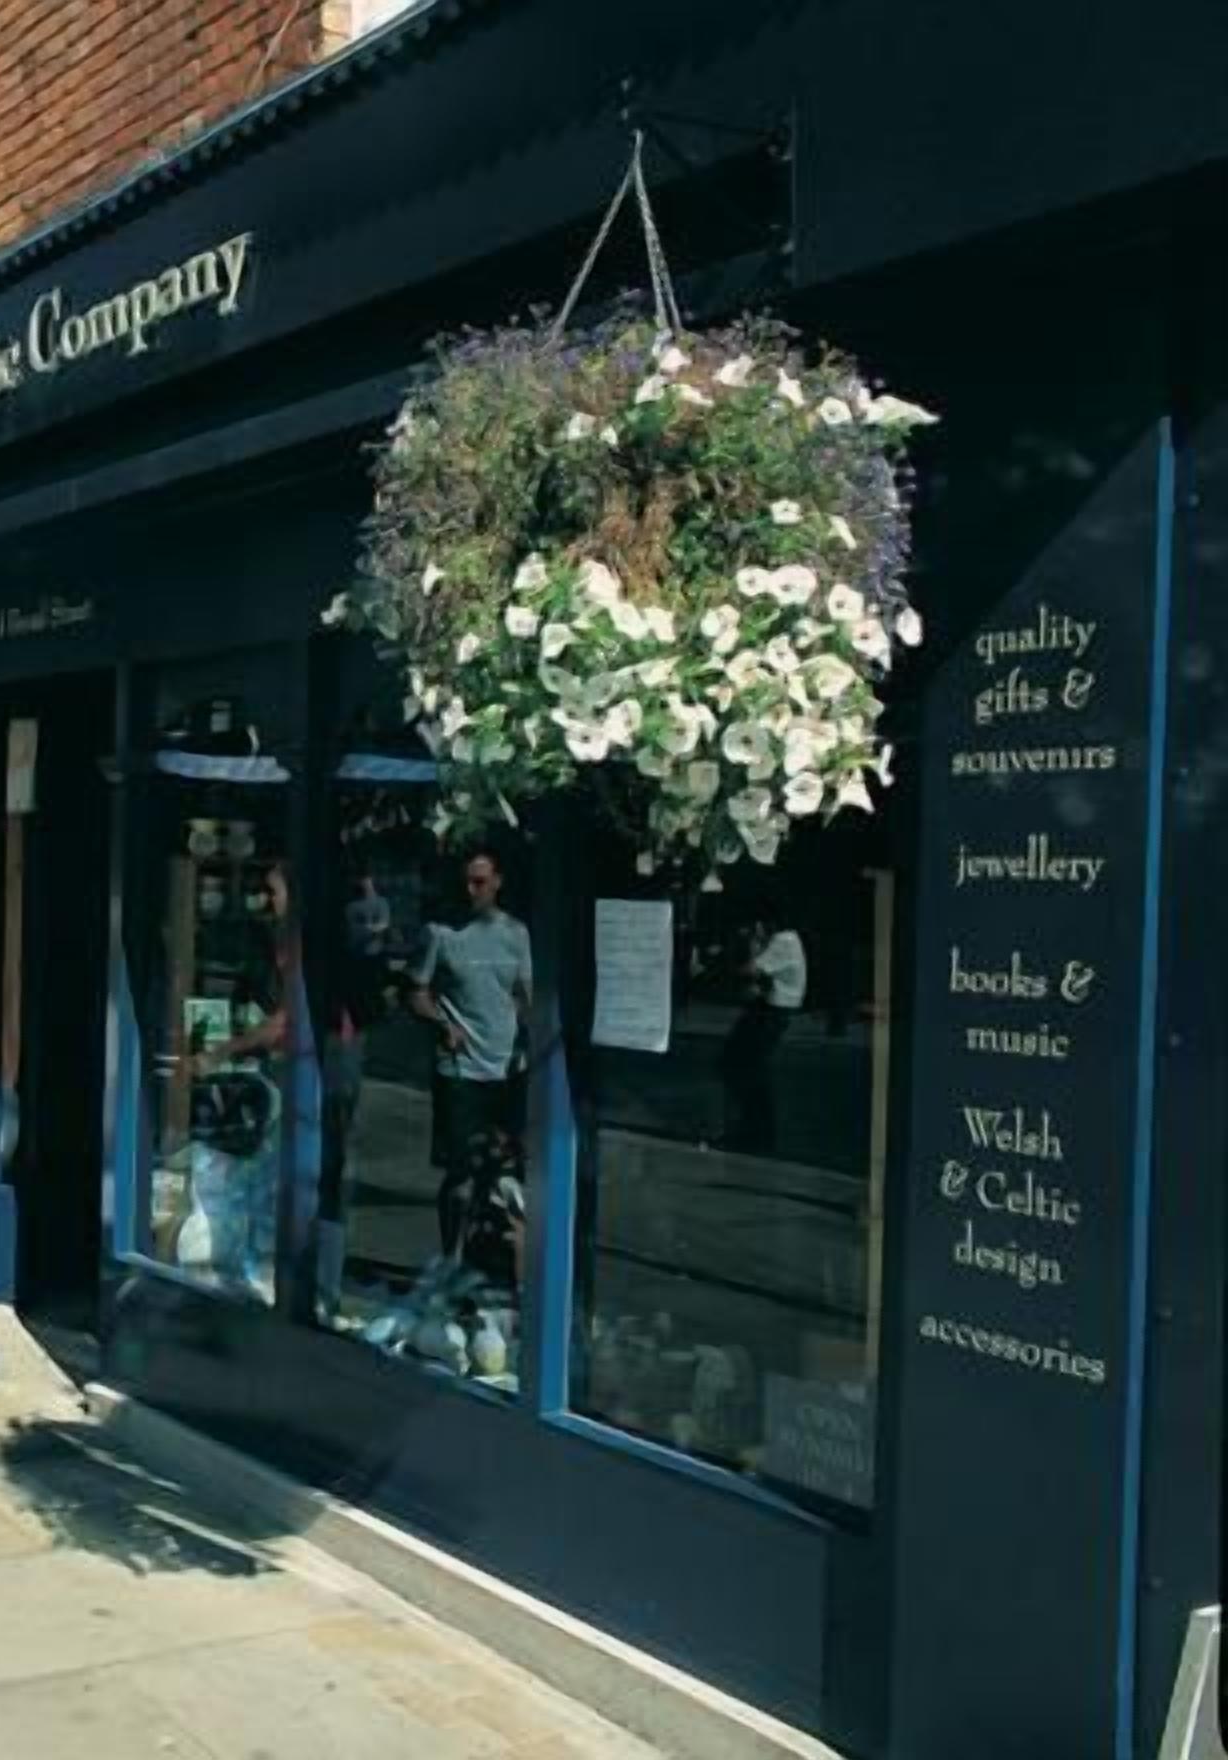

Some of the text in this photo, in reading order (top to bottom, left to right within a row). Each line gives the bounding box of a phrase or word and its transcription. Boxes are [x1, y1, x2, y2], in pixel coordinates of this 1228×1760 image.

[28, 231, 255, 374] Company
[975, 602, 1097, 665] quality
[975, 665, 1095, 725] gifts &
[951, 746, 1115, 776] souvenirs
[955, 832, 1106, 891] jewellery
[950, 945, 1096, 1004] books &
[966, 1022, 1070, 1058] music
[963, 1105, 1063, 1160] Welsh
[940, 1159, 1082, 1226] & Celtic
[954, 1218, 1064, 1289] design
[920, 1315, 1107, 1384] accessories
